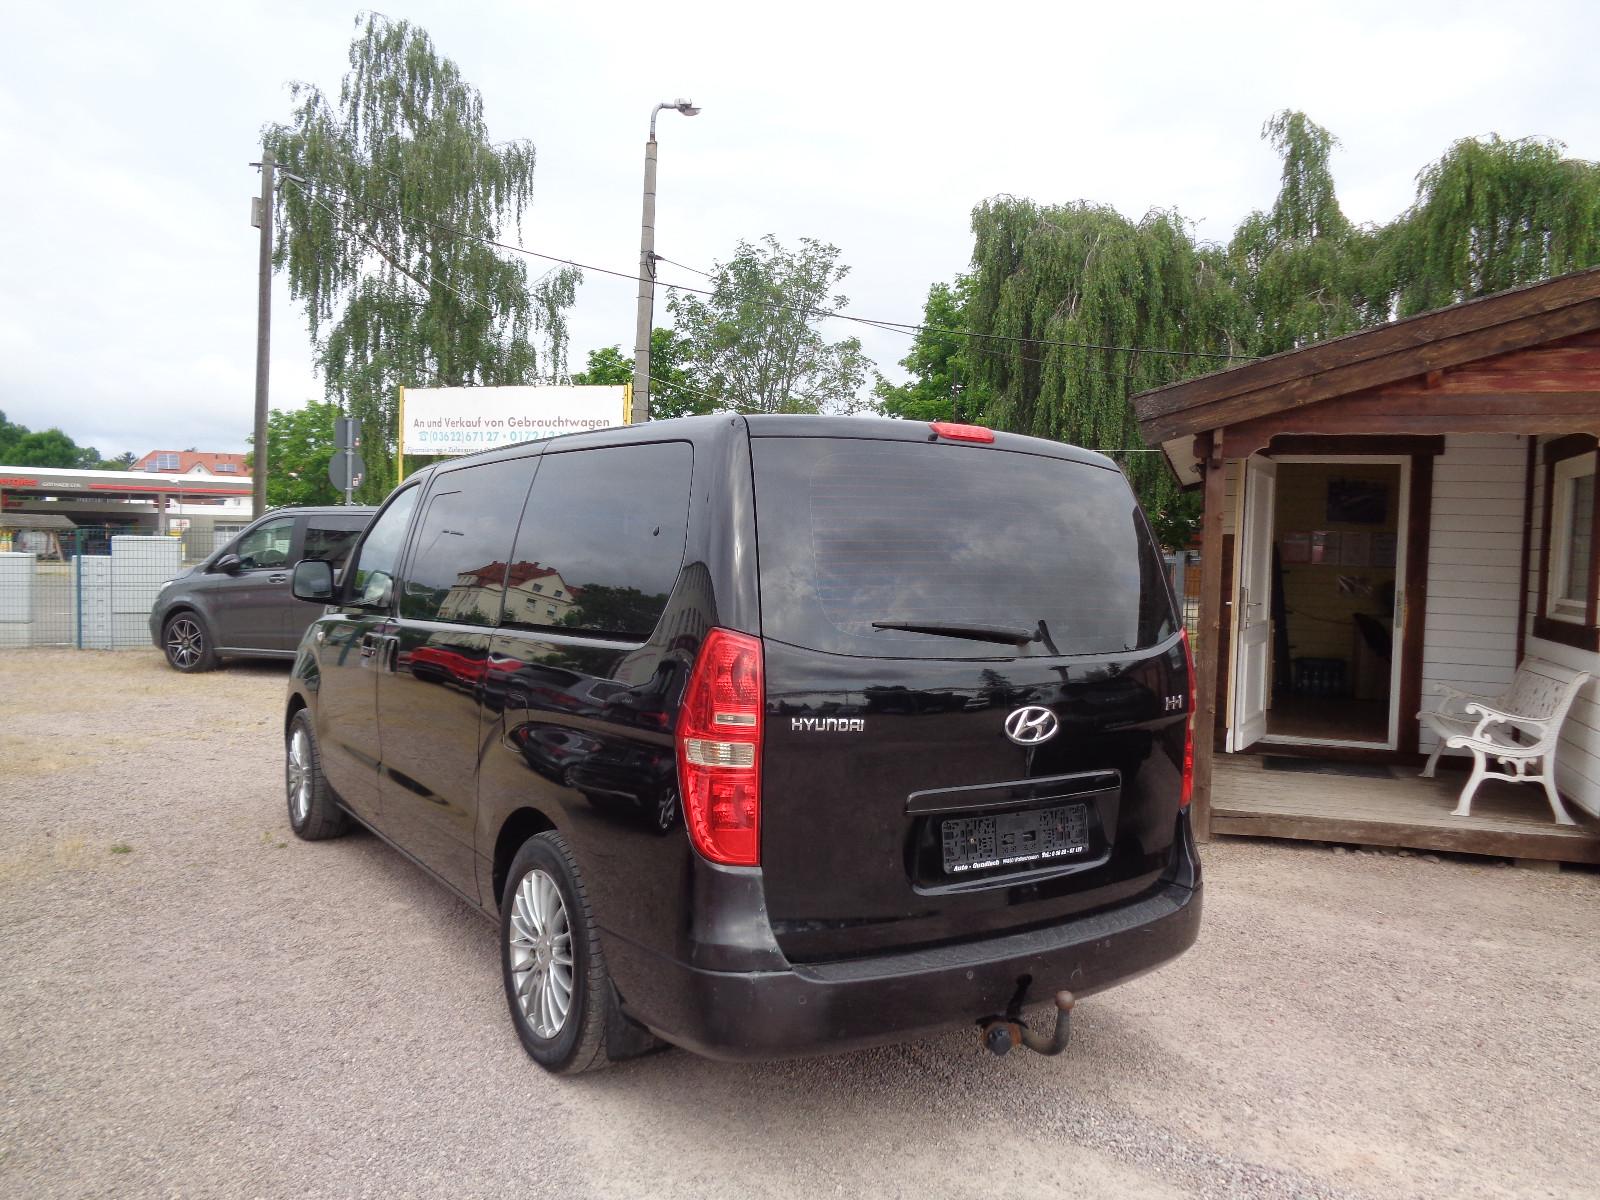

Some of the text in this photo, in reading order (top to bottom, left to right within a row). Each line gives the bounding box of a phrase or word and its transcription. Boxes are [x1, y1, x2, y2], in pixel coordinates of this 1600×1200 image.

[413, 416, 611, 430] An und Verkauf von Gebrauchtwagen
[791, 717, 865, 732] HYUNDAI
